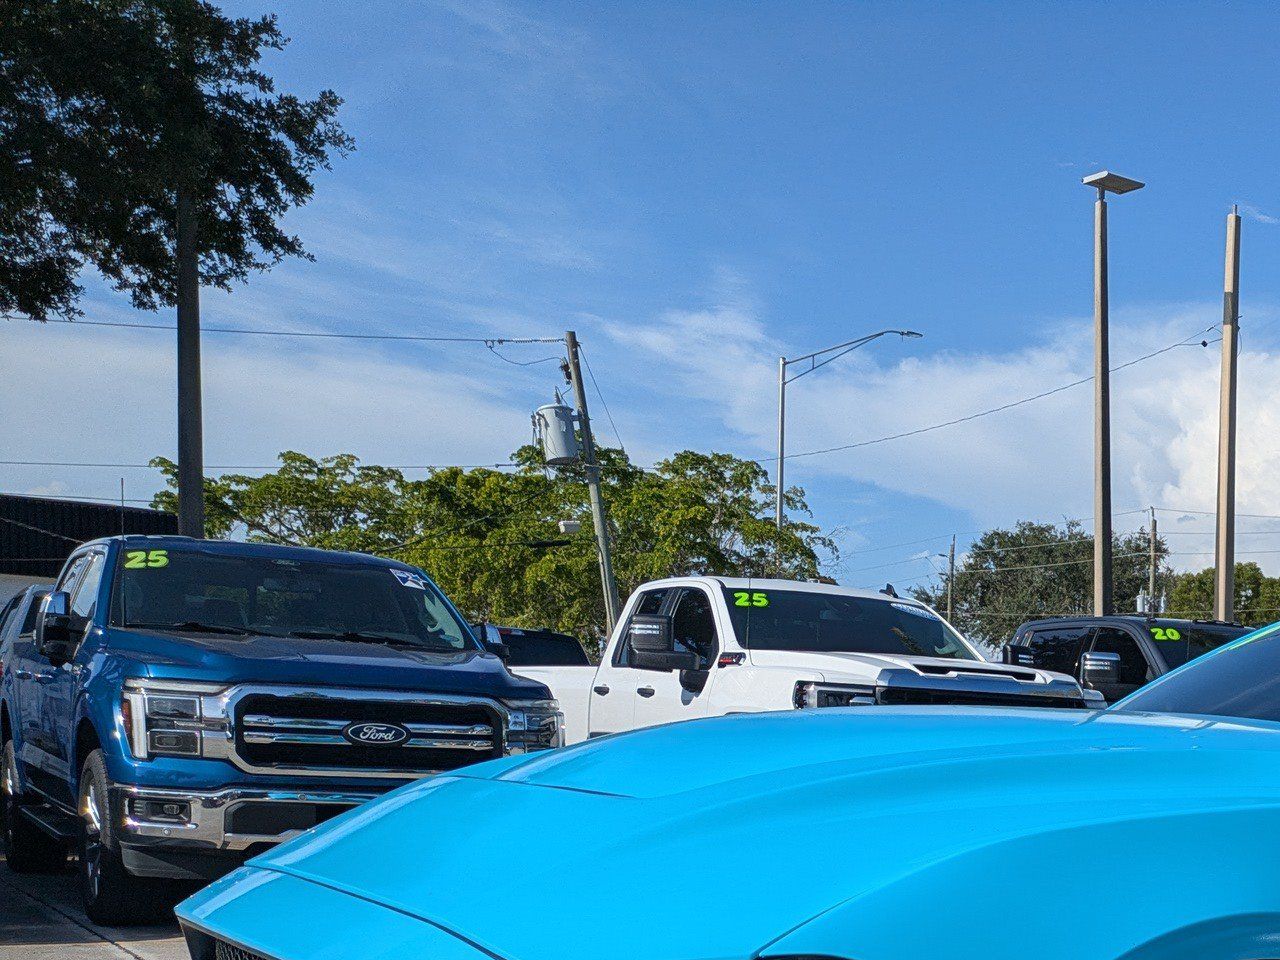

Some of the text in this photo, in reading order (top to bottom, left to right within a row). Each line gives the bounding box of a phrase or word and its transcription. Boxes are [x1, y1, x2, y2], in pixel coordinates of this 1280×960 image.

[125, 550, 169, 569] 25
[733, 592, 769, 607] 25
[1150, 627, 1181, 640] 20
[360, 726, 395, 740] Ford
